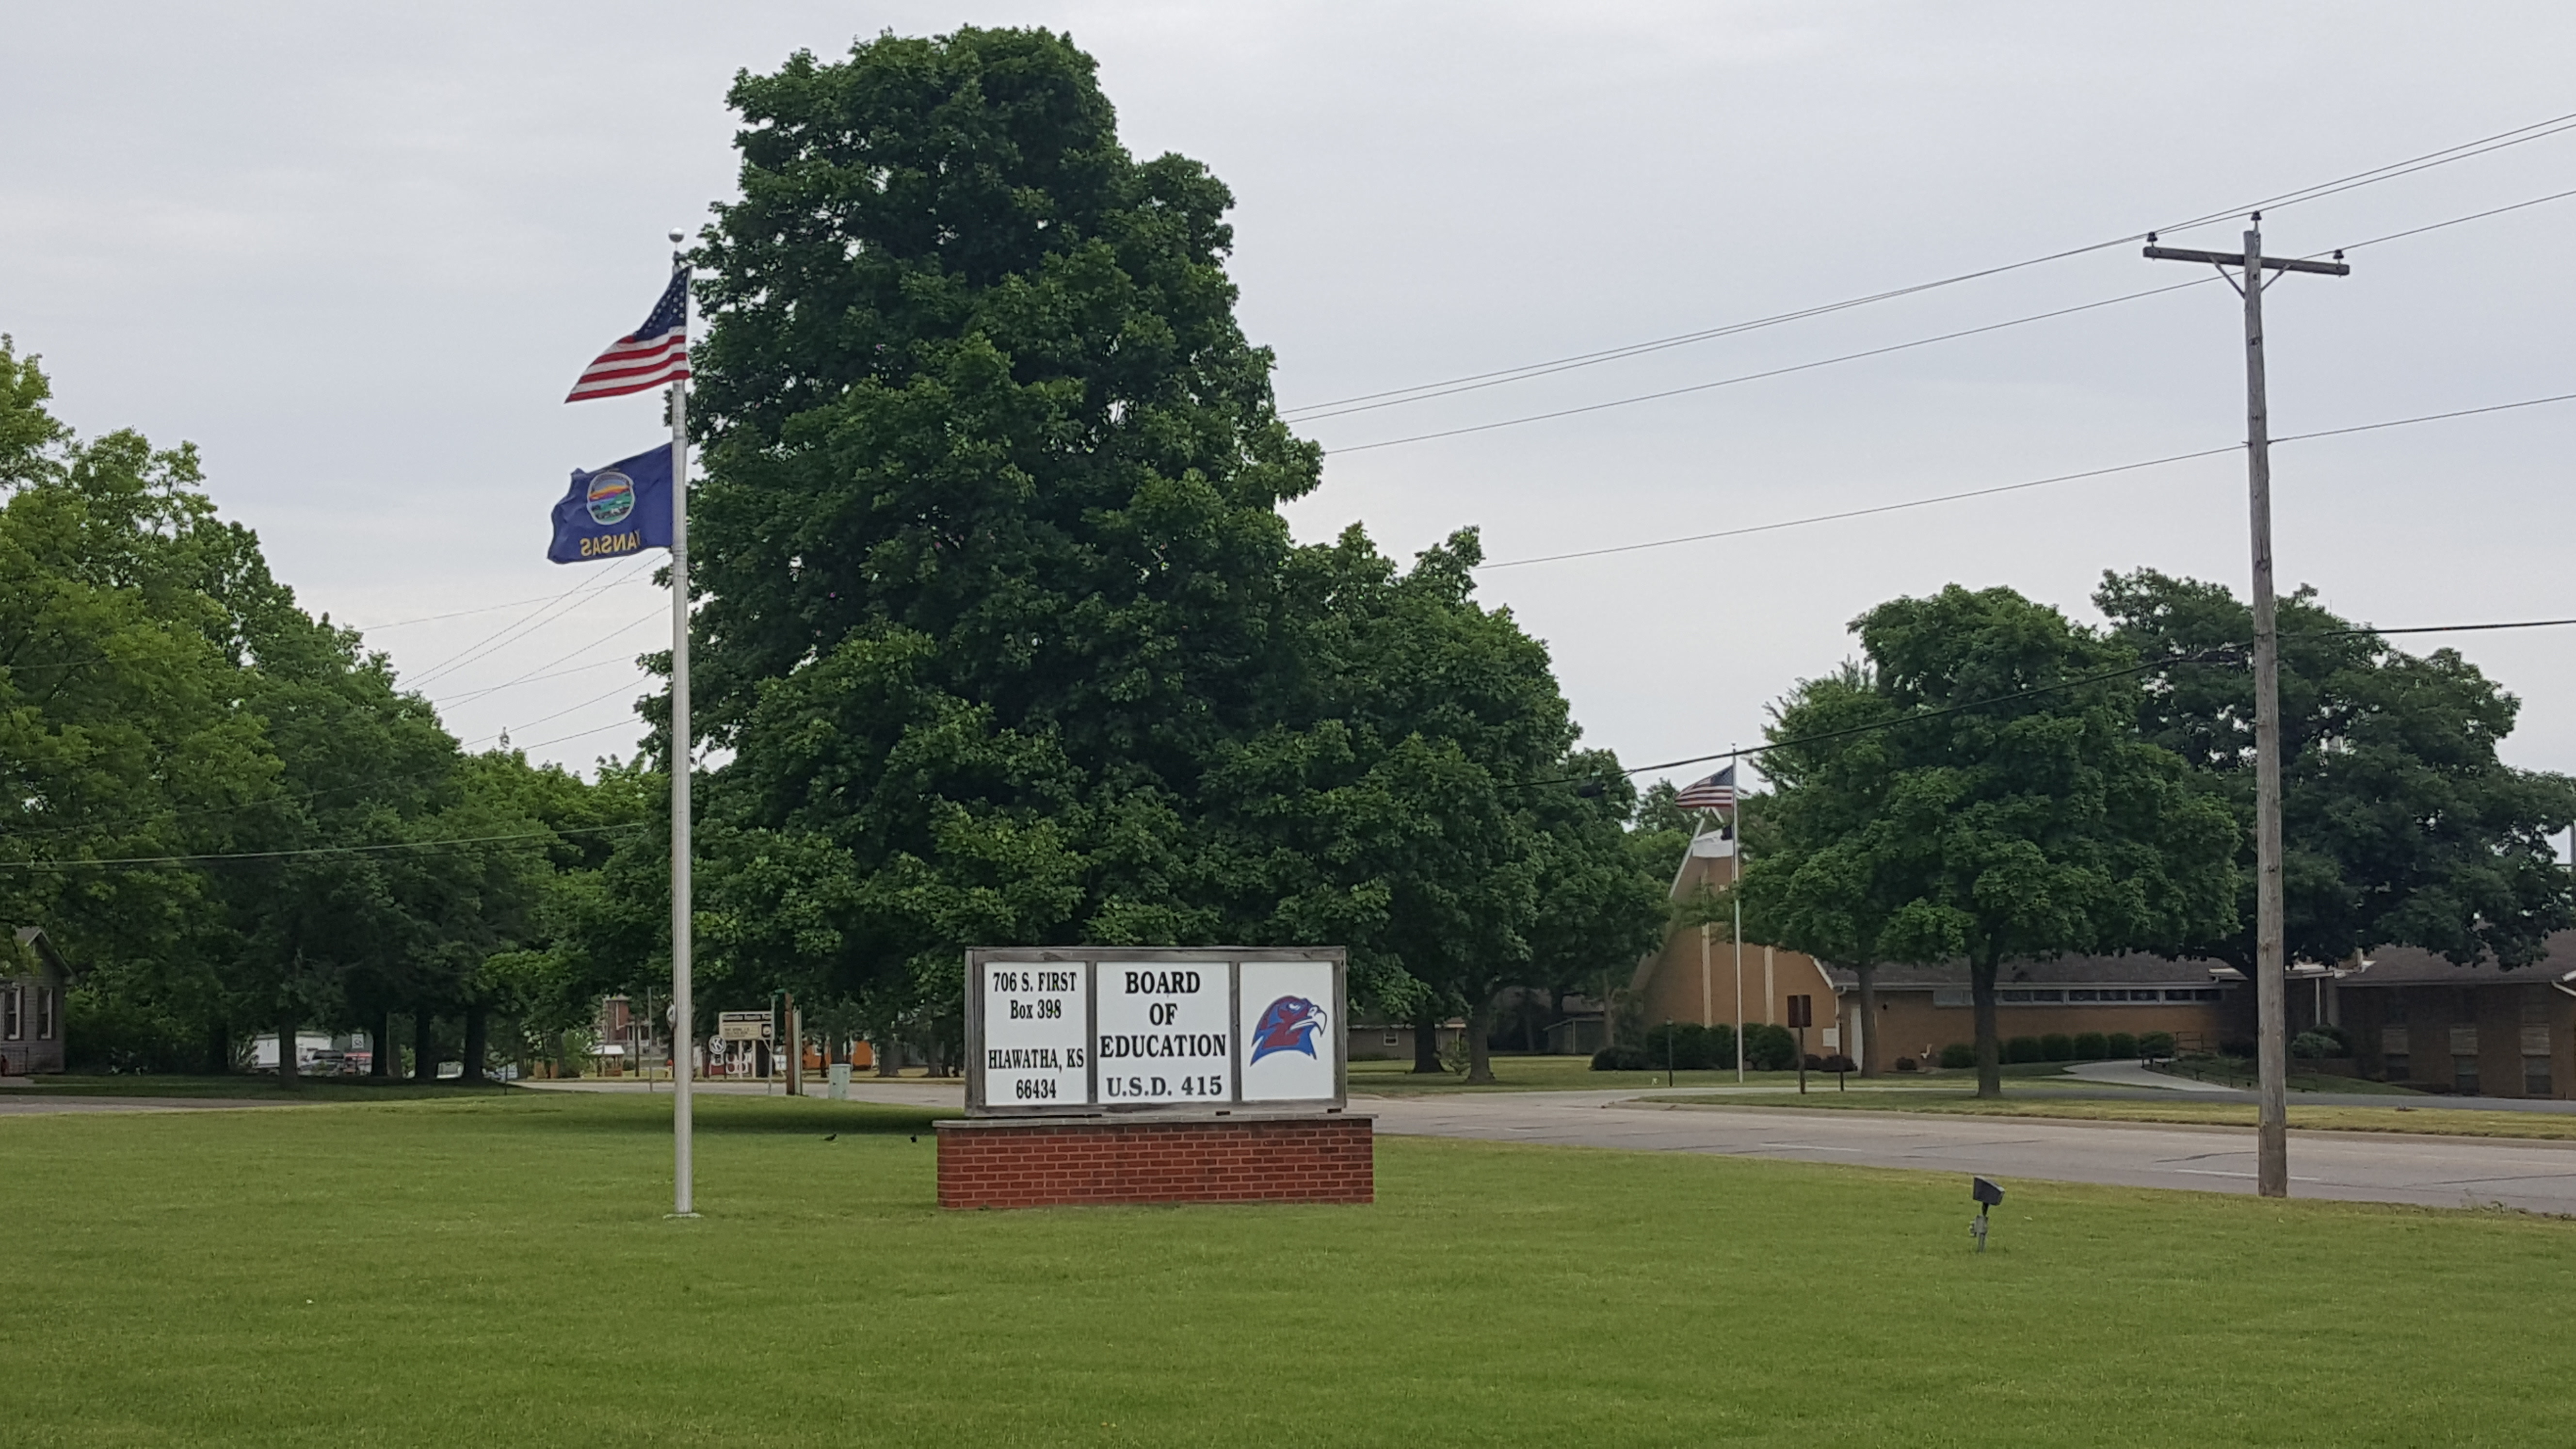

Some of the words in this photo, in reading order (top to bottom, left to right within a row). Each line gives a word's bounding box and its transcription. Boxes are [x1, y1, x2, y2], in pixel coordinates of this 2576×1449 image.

[993, 971, 1017, 992] 706
[1021, 971, 1033, 992] S.
[1038, 971, 1077, 992] FIRST
[1125, 971, 1201, 995] BOARD
[1010, 999, 1033, 1019] Box
[1037, 998, 1062, 1019] 398
[1149, 1002, 1178, 1026] OF
[1099, 1034, 1226, 1058] EDUCATION
[988, 1048, 1062, 1073] HIAWATHA,
[1066, 1048, 1084, 1068] KS
[1016, 1079, 1057, 1100] 66434
[1106, 1077, 1172, 1097] U.S.D.
[1181, 1075, 1223, 1096] 415
